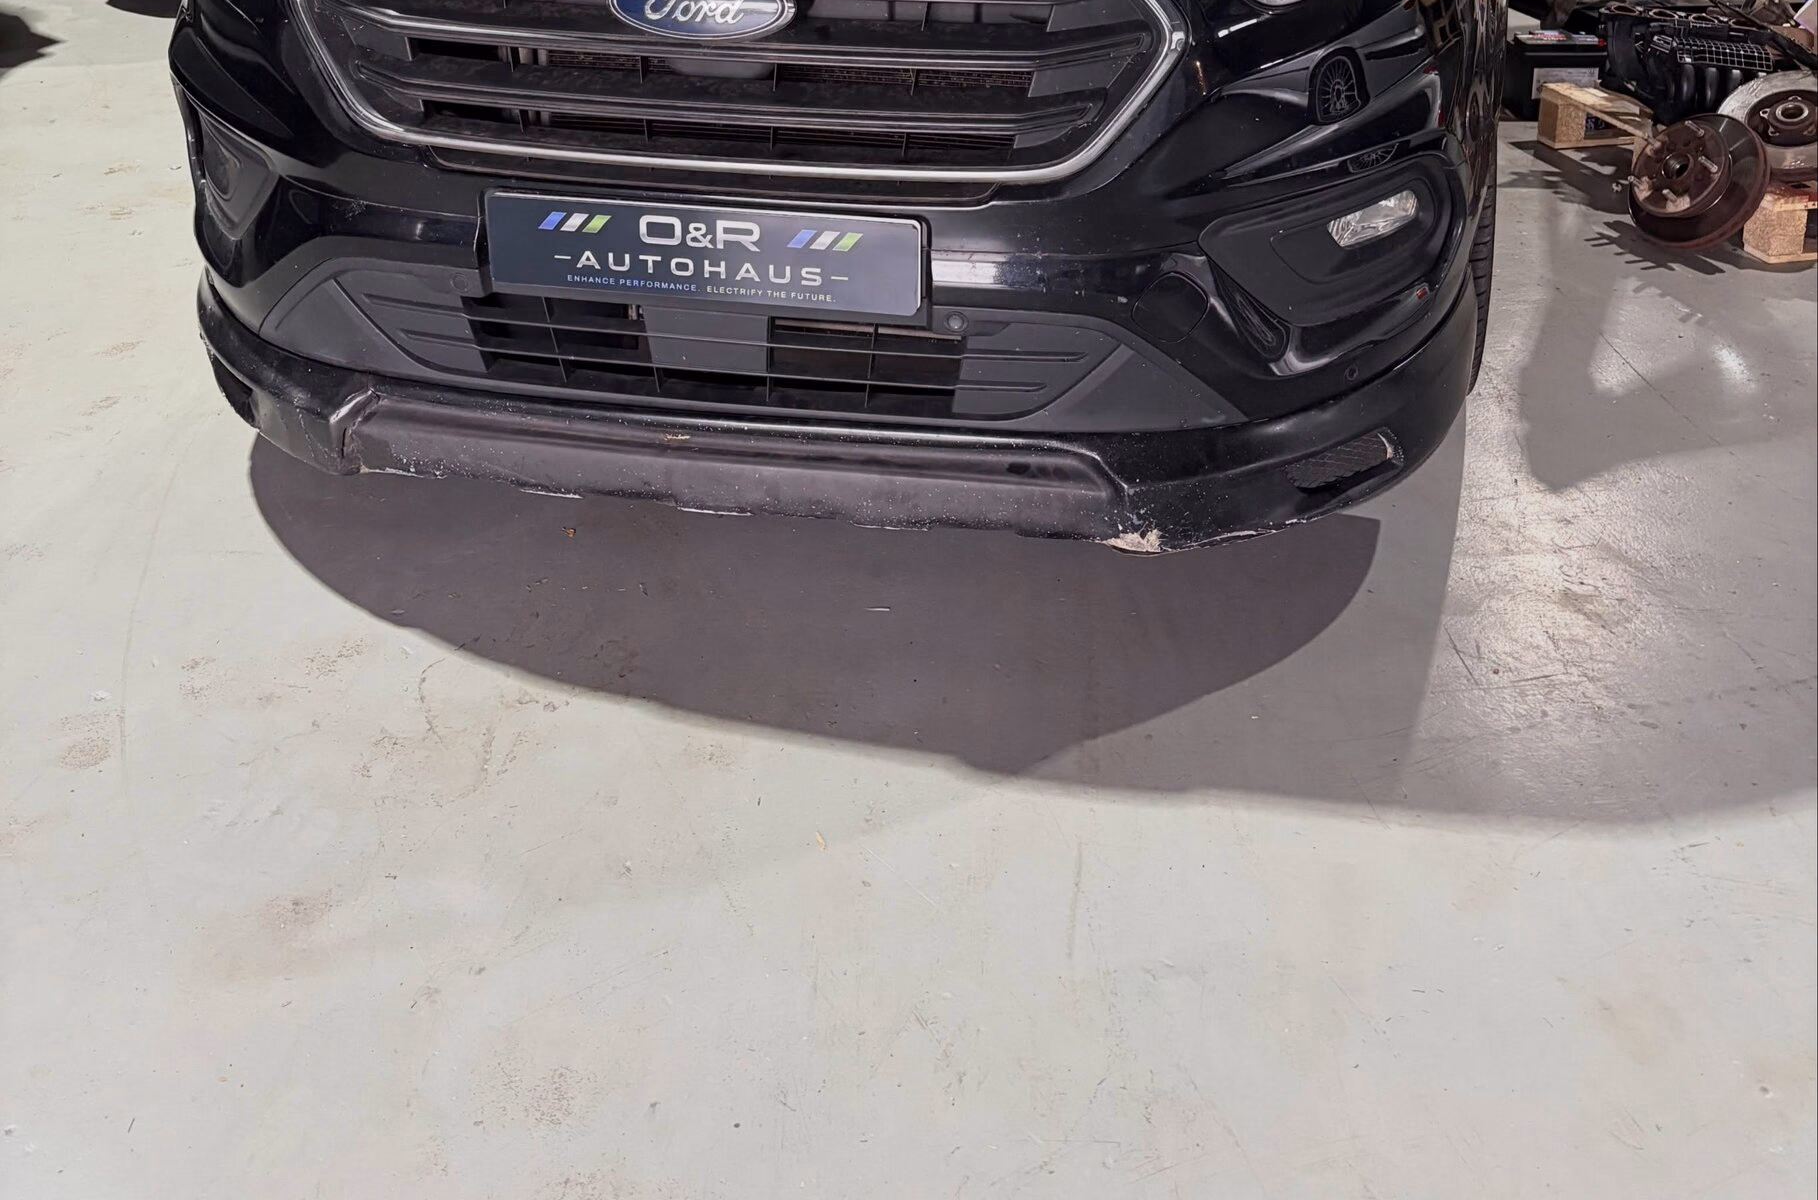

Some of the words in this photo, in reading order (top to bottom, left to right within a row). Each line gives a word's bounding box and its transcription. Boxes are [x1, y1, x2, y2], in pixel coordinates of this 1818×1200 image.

[639, 214, 761, 252] O&R
[576, 250, 822, 286] AUTOHAUS
[567, 274, 616, 285] ENHANCE
[619, 278, 700, 292] PERFORMANCE.
[706, 285, 763, 297] ELECTRIFY
[767, 290, 787, 299] THE
[791, 292, 836, 302] FUTURE.
